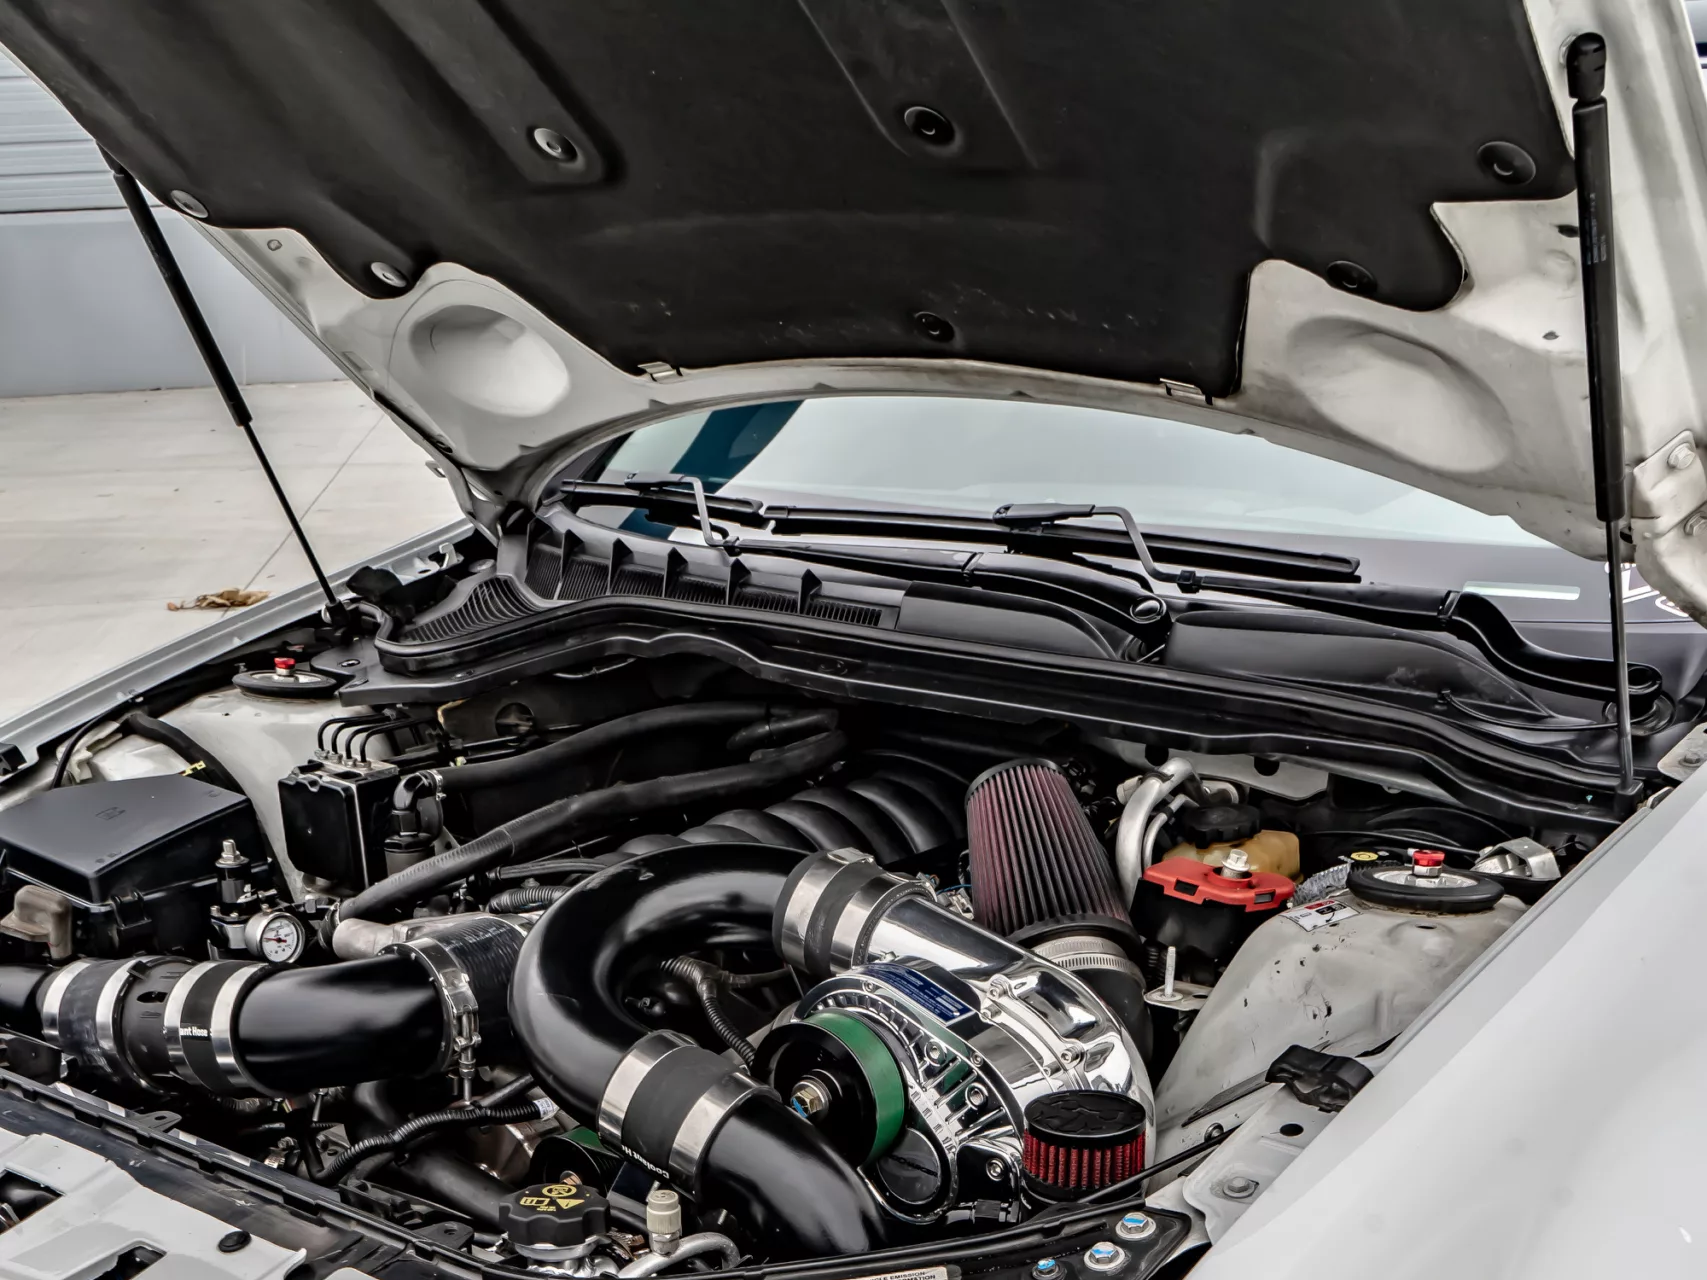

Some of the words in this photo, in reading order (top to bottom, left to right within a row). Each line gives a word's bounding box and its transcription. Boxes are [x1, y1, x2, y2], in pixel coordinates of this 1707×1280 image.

[192, 1026, 208, 1037] Hose
[633, 1151, 670, 1179] Coolant
[890, 1271, 925, 1280] EMISSION
